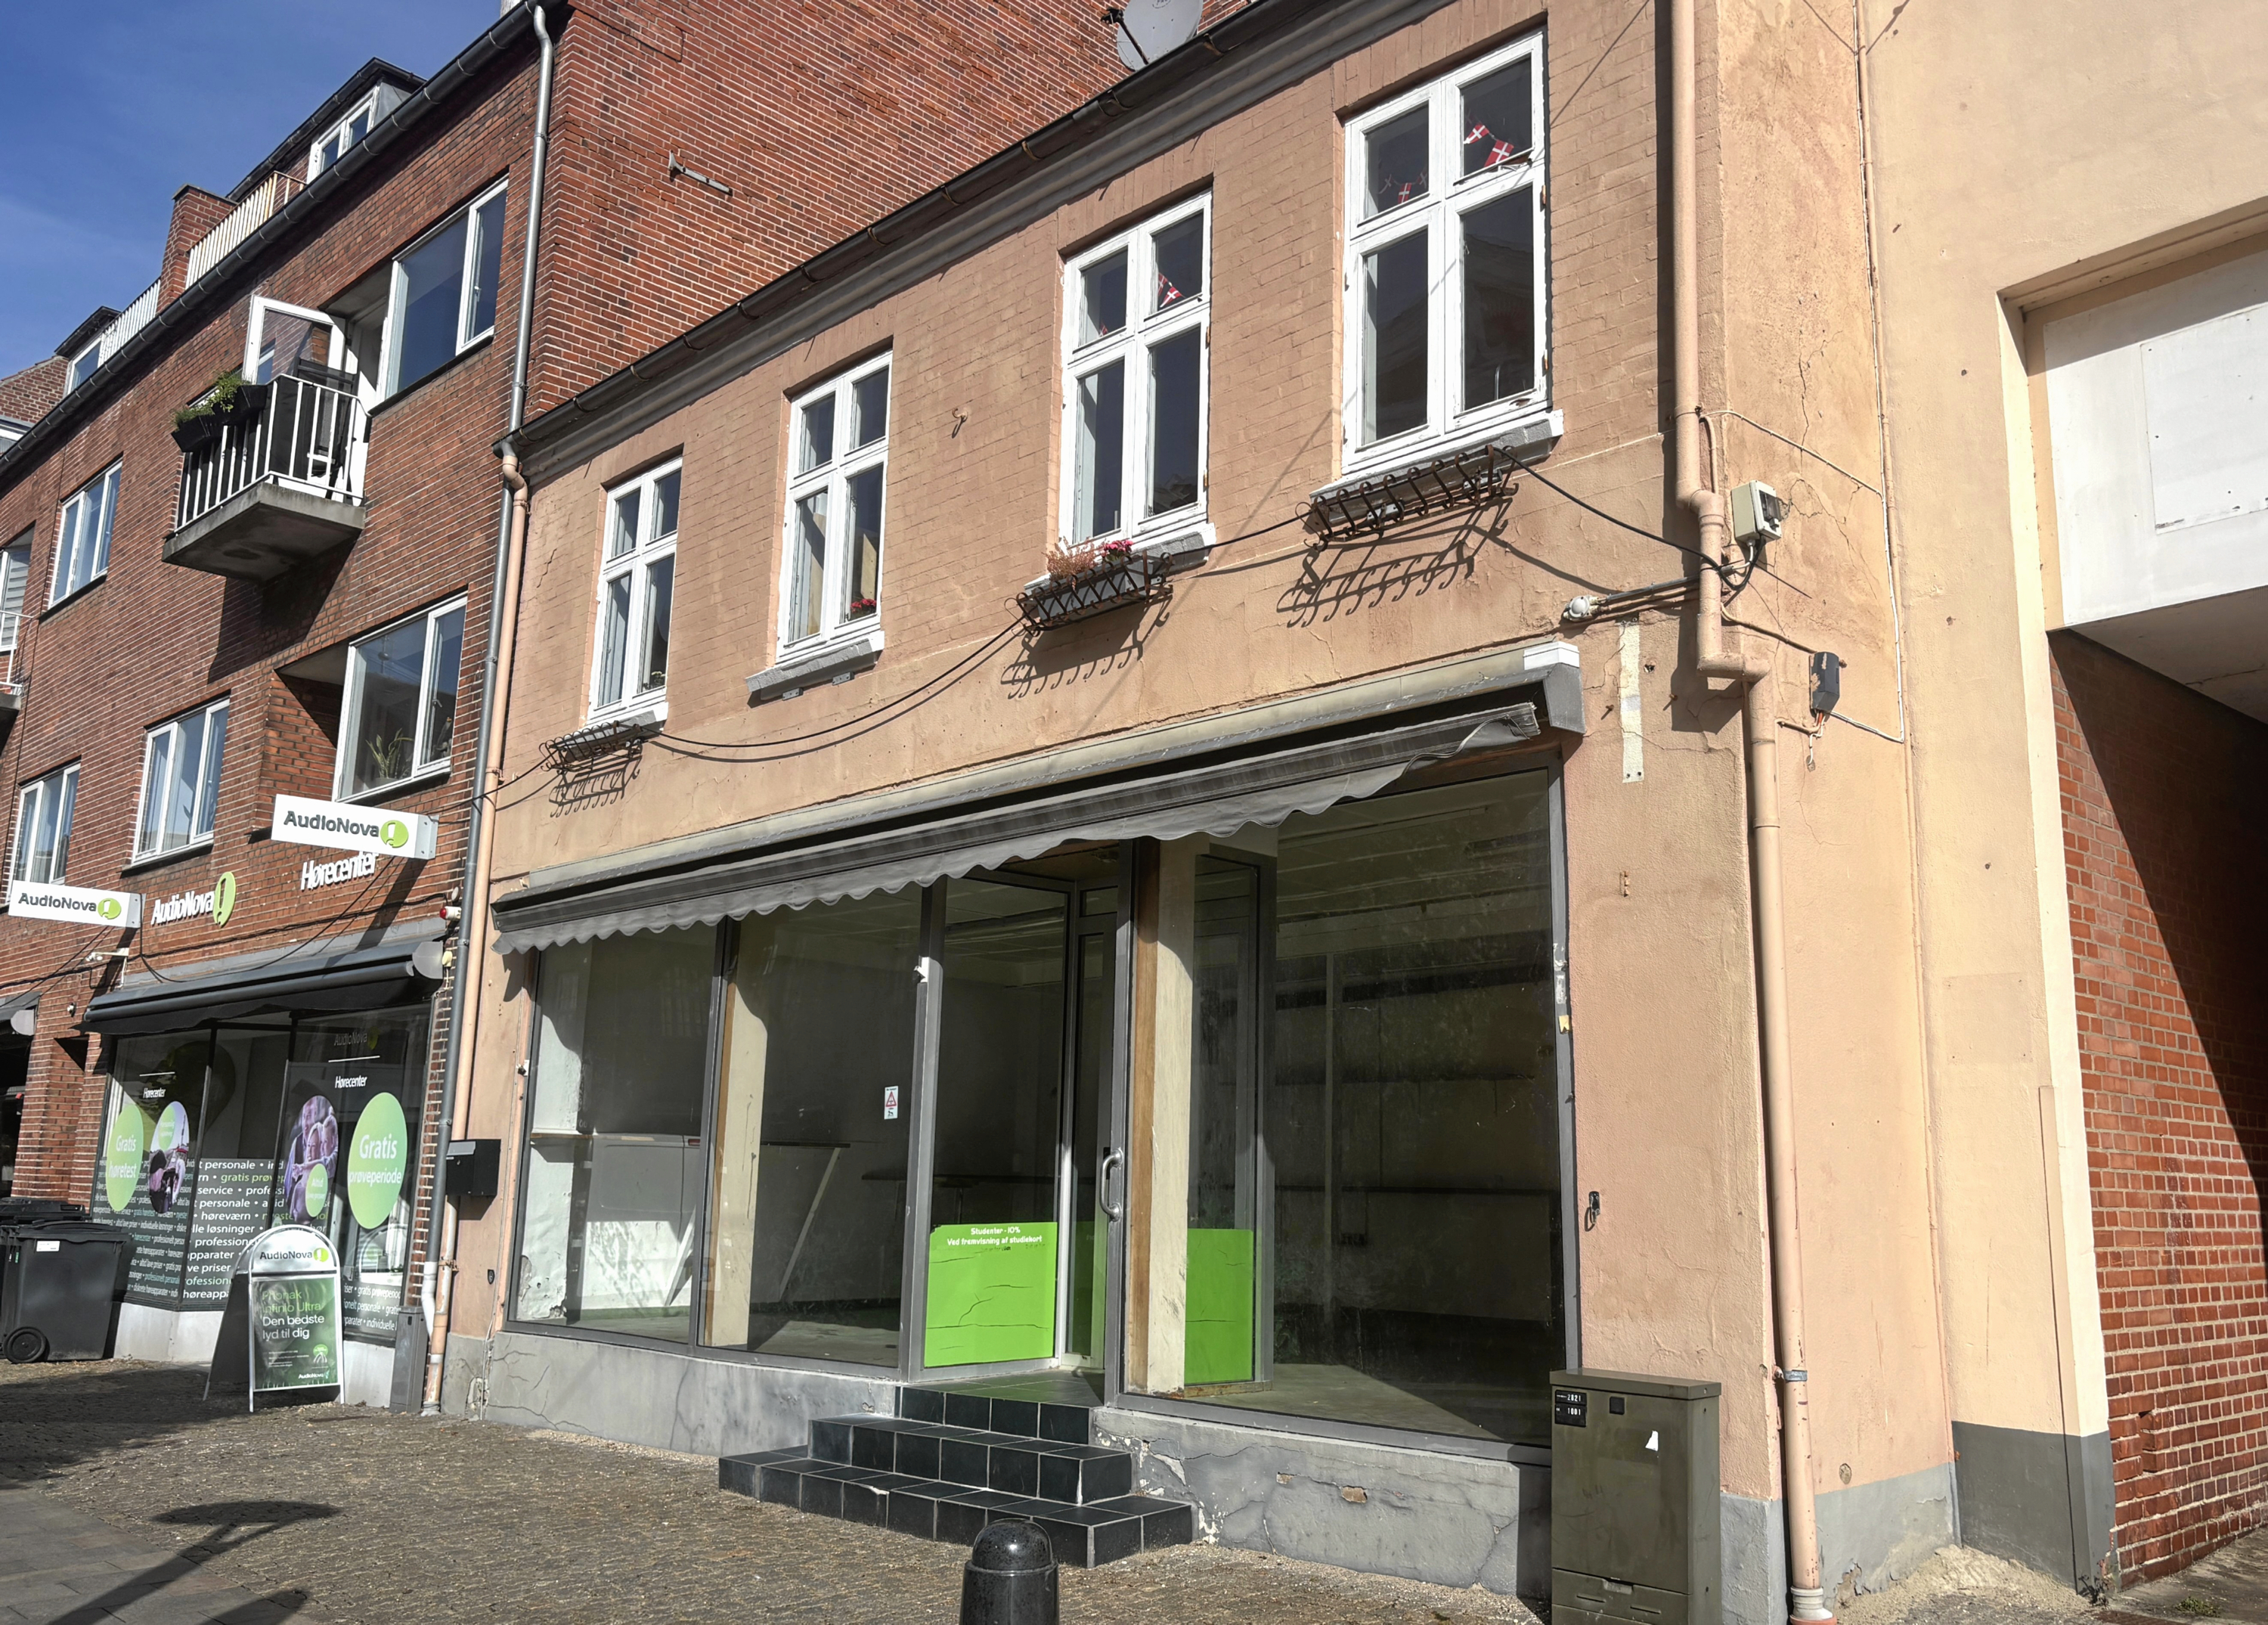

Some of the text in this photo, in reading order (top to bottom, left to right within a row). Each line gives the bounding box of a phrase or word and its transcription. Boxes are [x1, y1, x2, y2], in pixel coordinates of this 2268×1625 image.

[284, 811, 380, 837] AudioNova
[301, 851, 380, 891] Hørecenter
[18, 893, 97, 912] AudioNova
[151, 891, 215, 925] AudioNova
[334, 1032, 367, 1046] AudioNova
[335, 1075, 367, 1088] Hørecenter
[116, 1134, 136, 1152] Gratis
[359, 1133, 398, 1159] Gratis
[109, 1161, 136, 1178] høretest
[205, 1160, 256, 1171] personale
[221, 1173, 249, 1183] gratis
[349, 1168, 401, 1187] prøveperiode
[197, 1186, 234, 1195] service
[199, 1199, 250, 1209] personale
[201, 1211, 251, 1220] høreværn
[206, 1224, 255, 1235] løsninger
[962, 1237, 999, 1246] fremvisning
[259, 1251, 313, 1260] AudioNova
[202, 1264, 231, 1274] priser
[185, 1276, 231, 1285] ofession
[262, 1291, 302, 1301] Phonak
[358, 1286, 371, 1297] gratis
[297, 1301, 321, 1312] Ultra
[262, 1315, 324, 1326] Den bedste
[262, 1328, 309, 1341] lyd til dig
